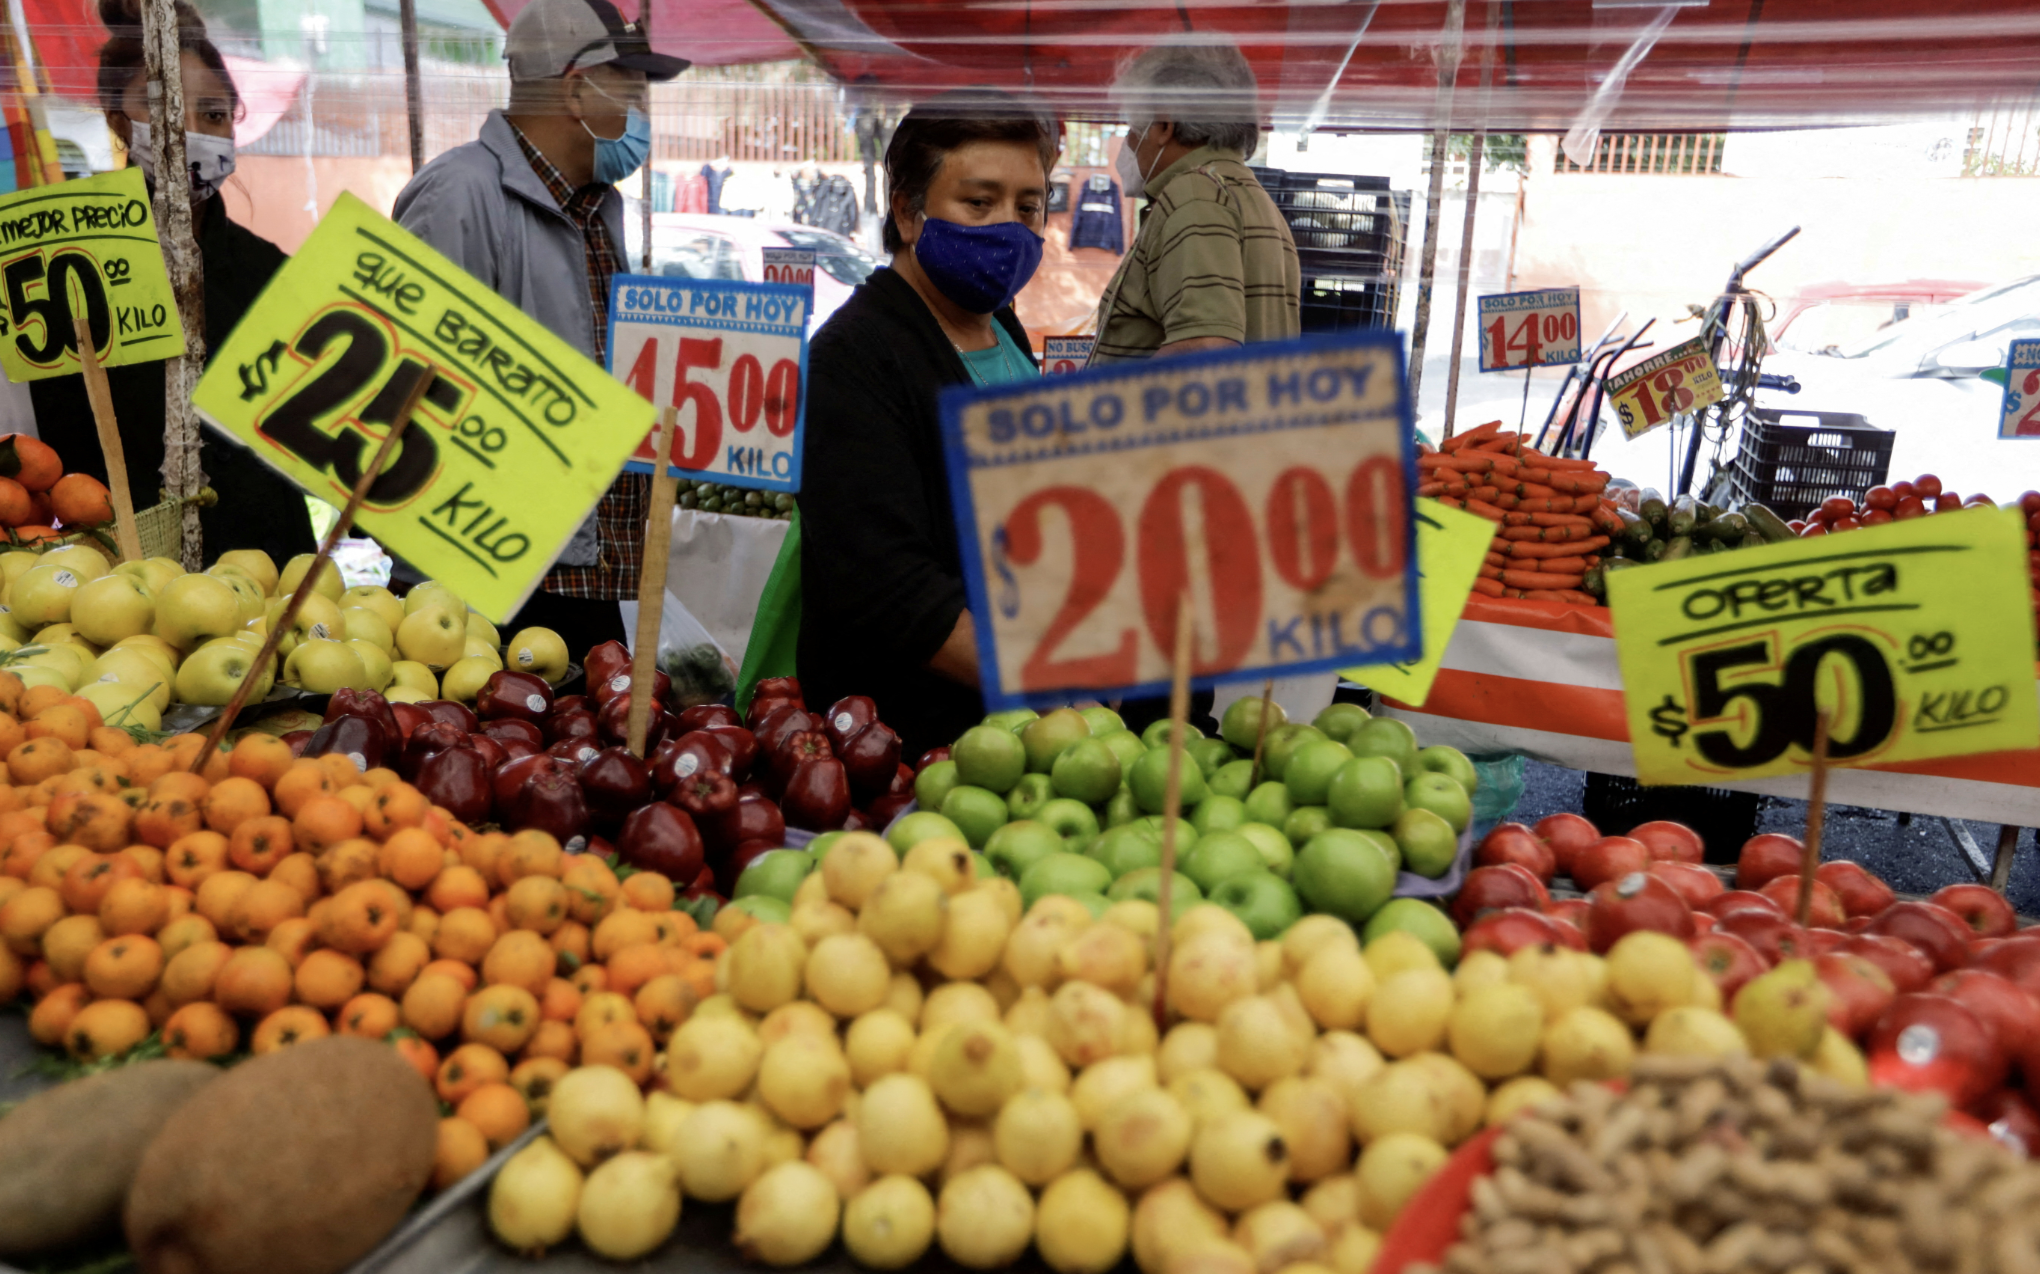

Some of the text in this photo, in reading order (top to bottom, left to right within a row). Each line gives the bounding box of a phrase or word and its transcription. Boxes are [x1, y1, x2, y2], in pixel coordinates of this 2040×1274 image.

[353, 251, 425, 314] que
[625, 288, 799, 323] SOLO POR HOY
[1484, 292, 1572, 308] SOLO POR HOY
[117, 304, 166, 335] KILO
[1048, 342, 1063, 353] NO
[1546, 349, 1579, 362] KILO
[1693, 371, 1713, 384] KILO
[988, 363, 1373, 444] SOLO POR HOY
[728, 445, 793, 479] KILO
[432, 482, 532, 562] KILO
[1268, 606, 1406, 659] KILO
[1913, 685, 2010, 728] KILO
